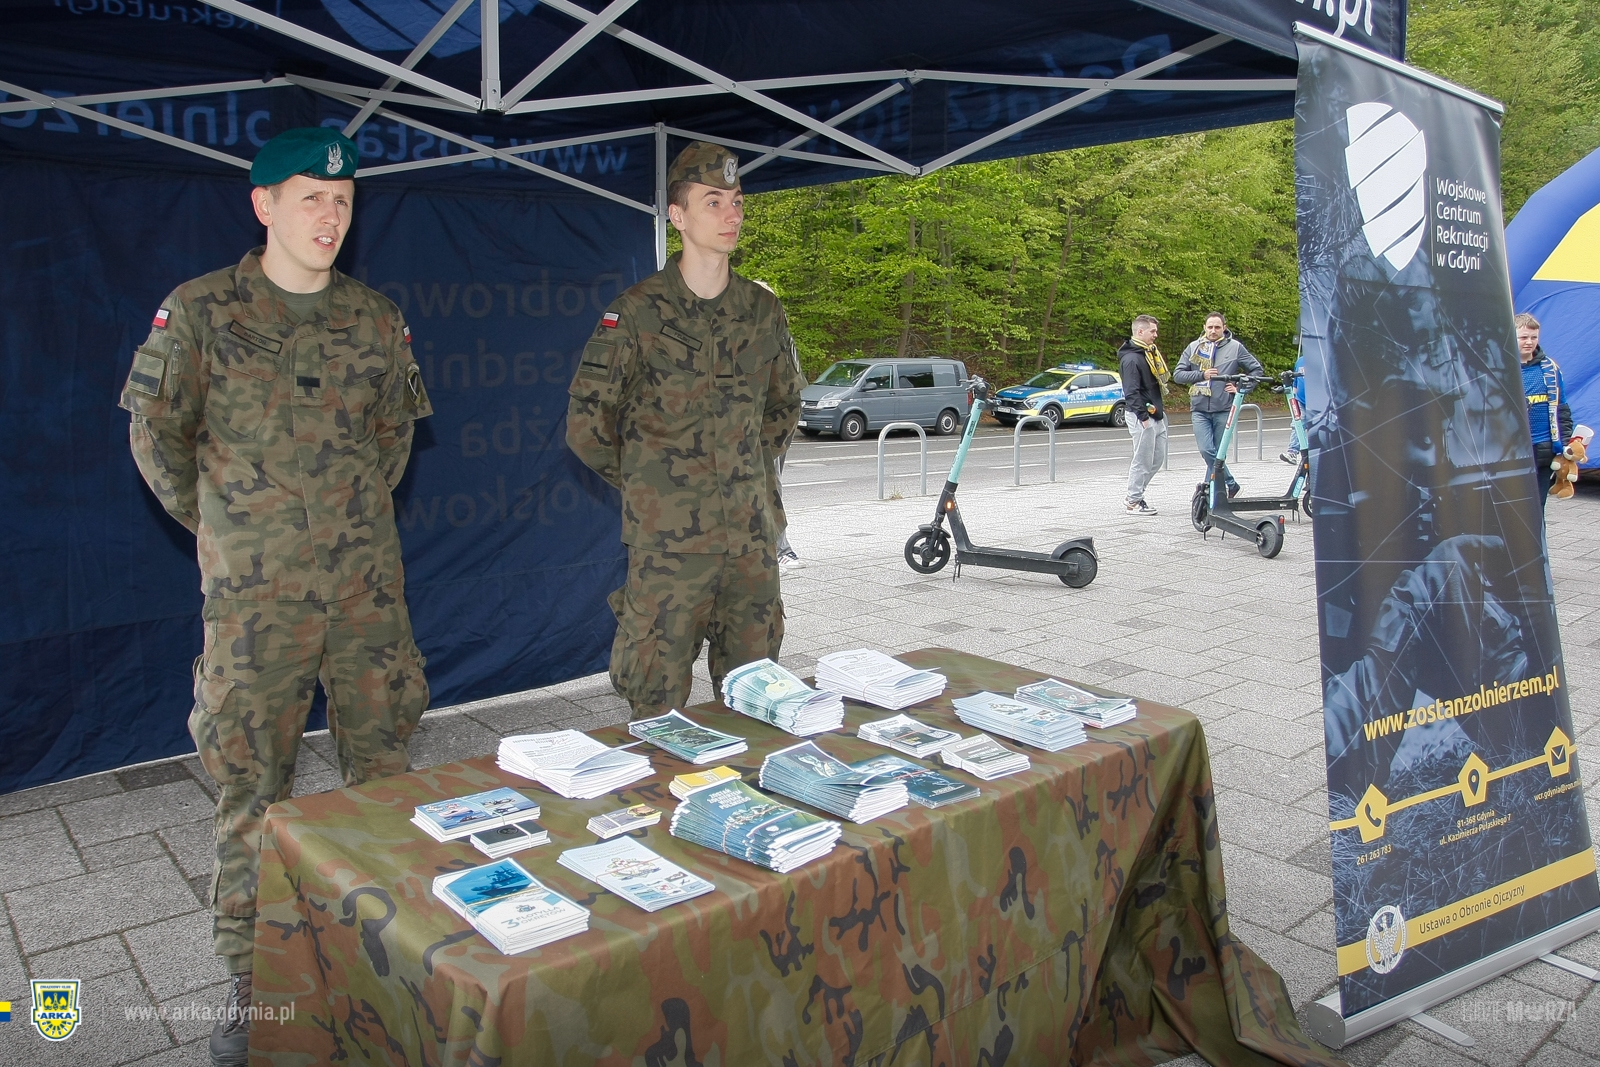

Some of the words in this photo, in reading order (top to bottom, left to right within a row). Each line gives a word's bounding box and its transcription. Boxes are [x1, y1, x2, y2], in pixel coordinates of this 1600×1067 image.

[1296, 0, 1373, 37] .pl
[1436, 177, 1486, 204] Wojskowe
[1436, 202, 1481, 225] Centrum
[1436, 225, 1487, 252] Rekrutacji
[1436, 252, 1446, 267] w
[1448, 251, 1480, 273] Gdyni
[1067, 393, 1086, 401] POLICJA
[1364, 666, 1559, 742] www.zostanzolnierzem.pl
[1476, 809, 1495, 821] Gdynia
[1448, 827, 1478, 842] Kazimierza
[1356, 854, 1368, 865] 261
[1419, 915, 1451, 934] Ustawa
[1452, 913, 1458, 921] o
[1459, 898, 1492, 919] Obronie
[1493, 884, 1525, 905] Ojczyzny
[501, 919, 520, 928] 3
